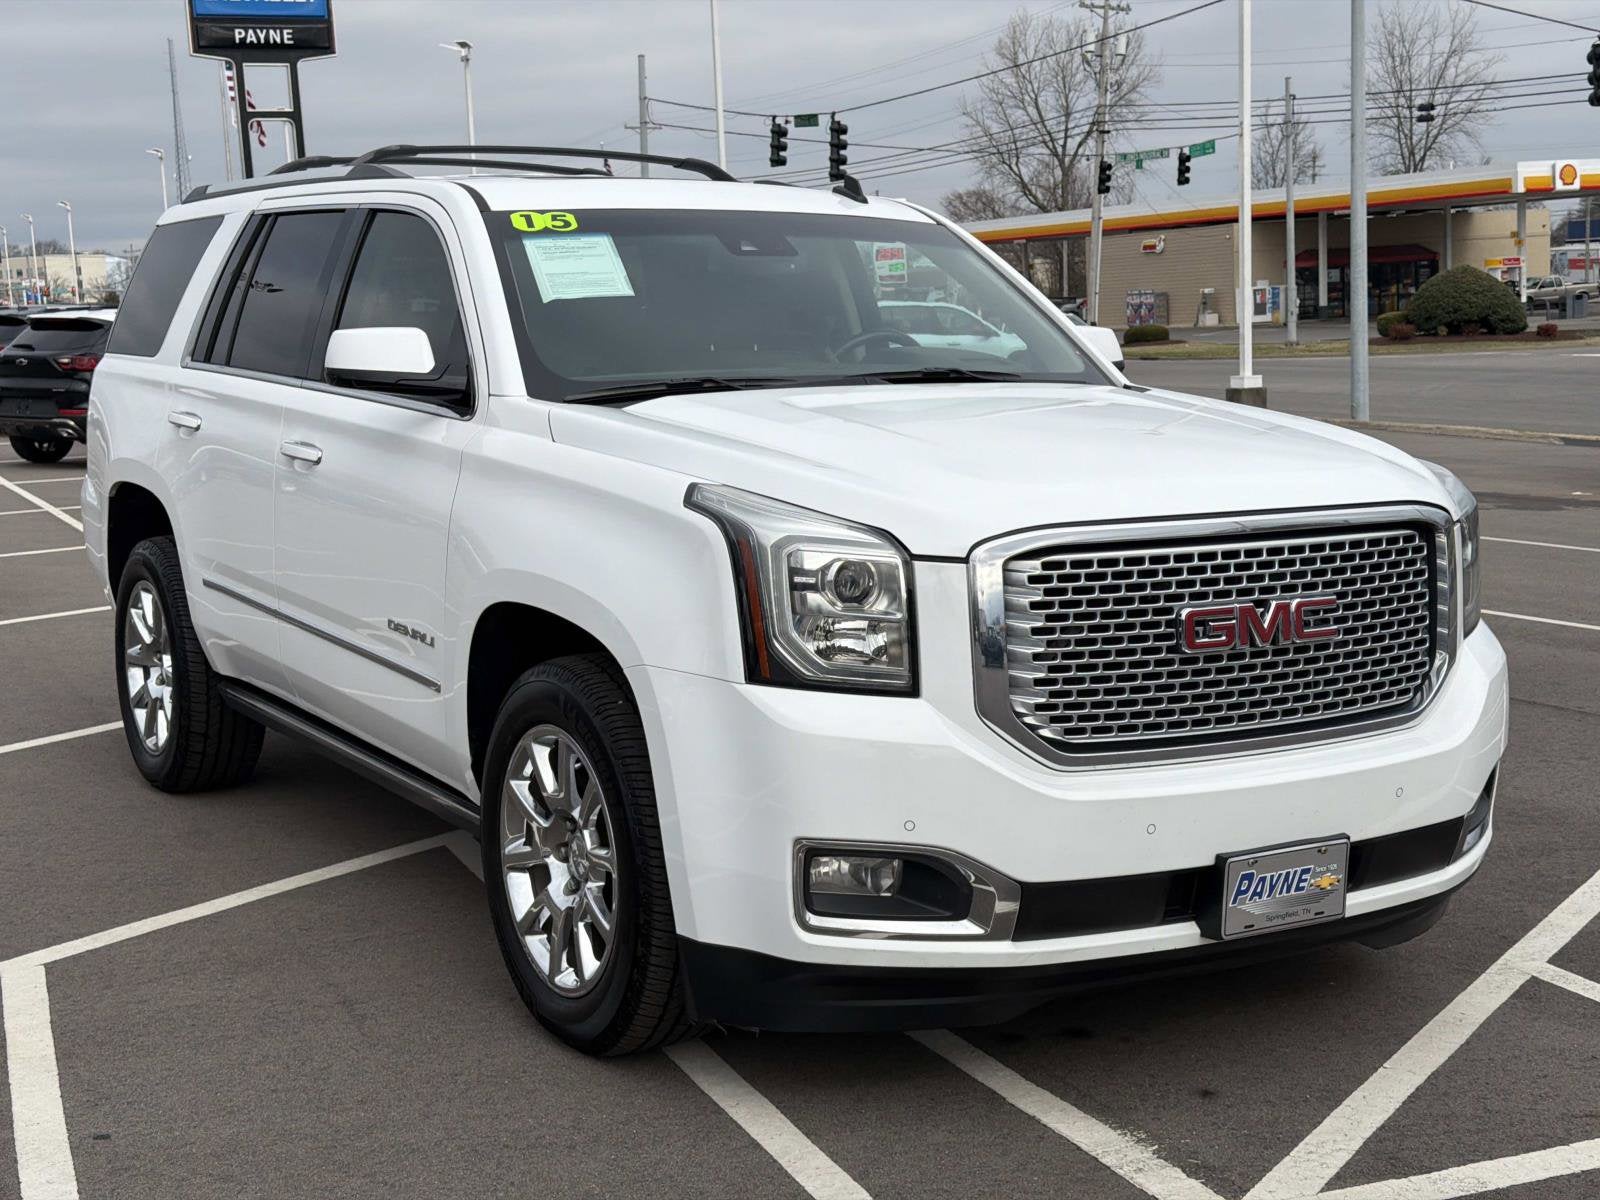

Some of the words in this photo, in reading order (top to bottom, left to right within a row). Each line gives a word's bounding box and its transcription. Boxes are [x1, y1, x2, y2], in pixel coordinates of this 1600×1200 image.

[234, 28, 295, 45] PAYNE
[516, 212, 574, 230] 15
[387, 618, 435, 648] DENALI
[1181, 595, 1338, 653] GMC
[1302, 907, 1311, 915] TN
